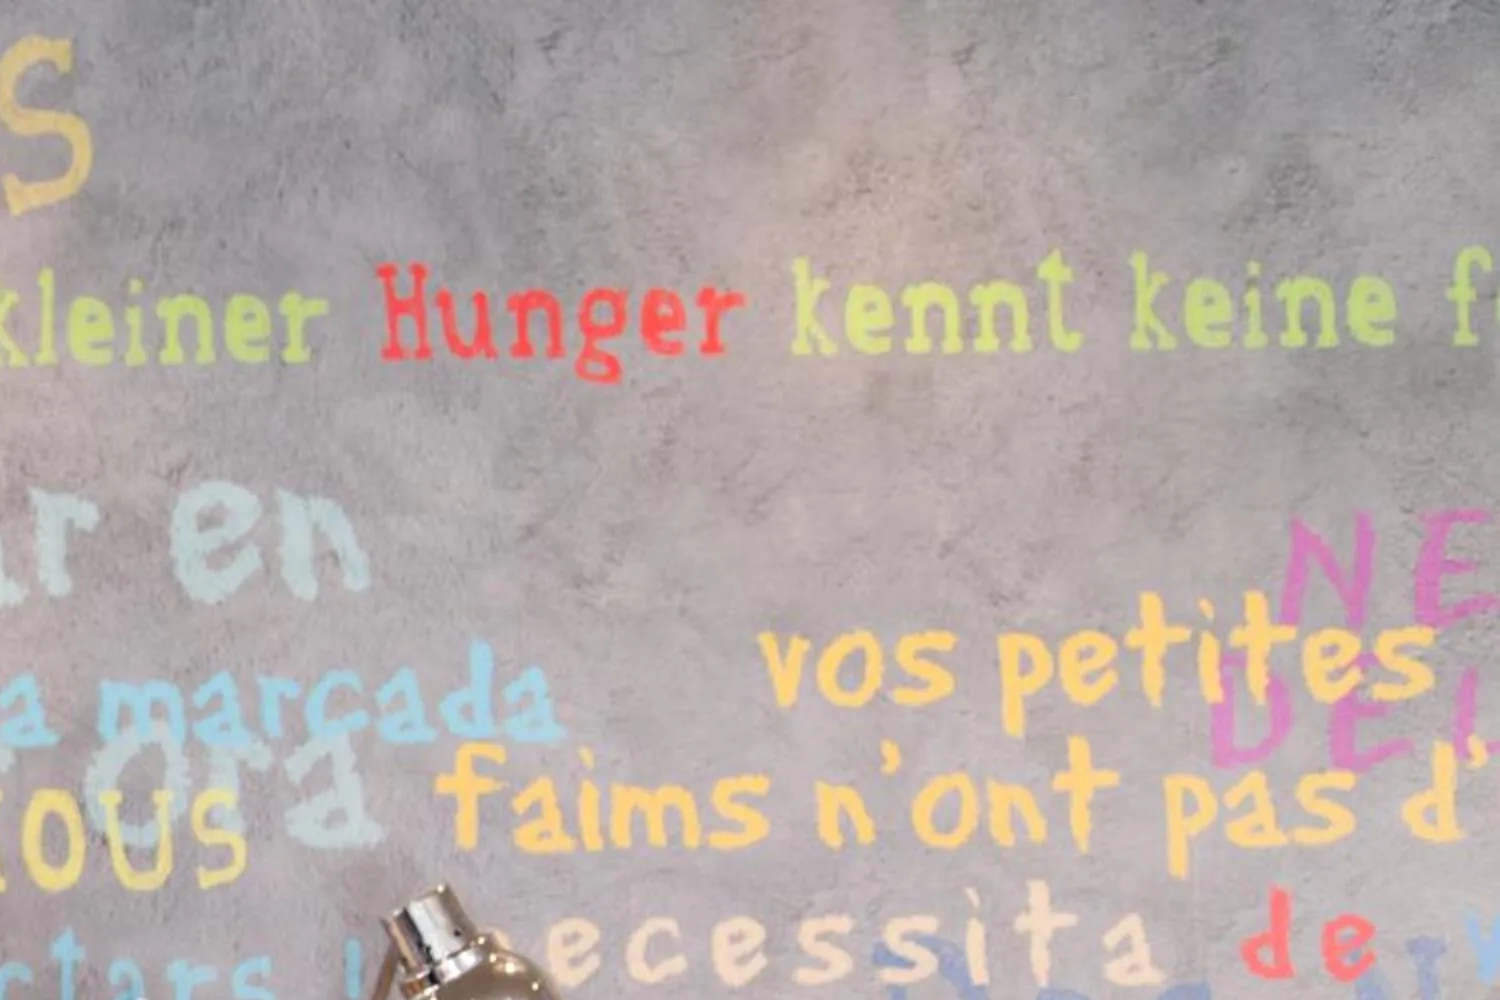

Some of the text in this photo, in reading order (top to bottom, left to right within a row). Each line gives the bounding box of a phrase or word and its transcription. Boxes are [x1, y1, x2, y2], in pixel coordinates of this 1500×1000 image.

[375, 263, 745, 385] Hunger
[791, 249, 1083, 356] kennt
[1128, 250, 1397, 352] keine
[1446, 244, 1500, 348] f
[170, 480, 371, 604] en
[98, 636, 568, 748] marcada
[756, 589, 1436, 738] vos petites
[434, 743, 772, 855] faims
[814, 735, 1120, 853] n'ont
[1162, 768, 1356, 878] pas
[485, 880, 1166, 987] ecessita
[1240, 885, 1377, 982] de
